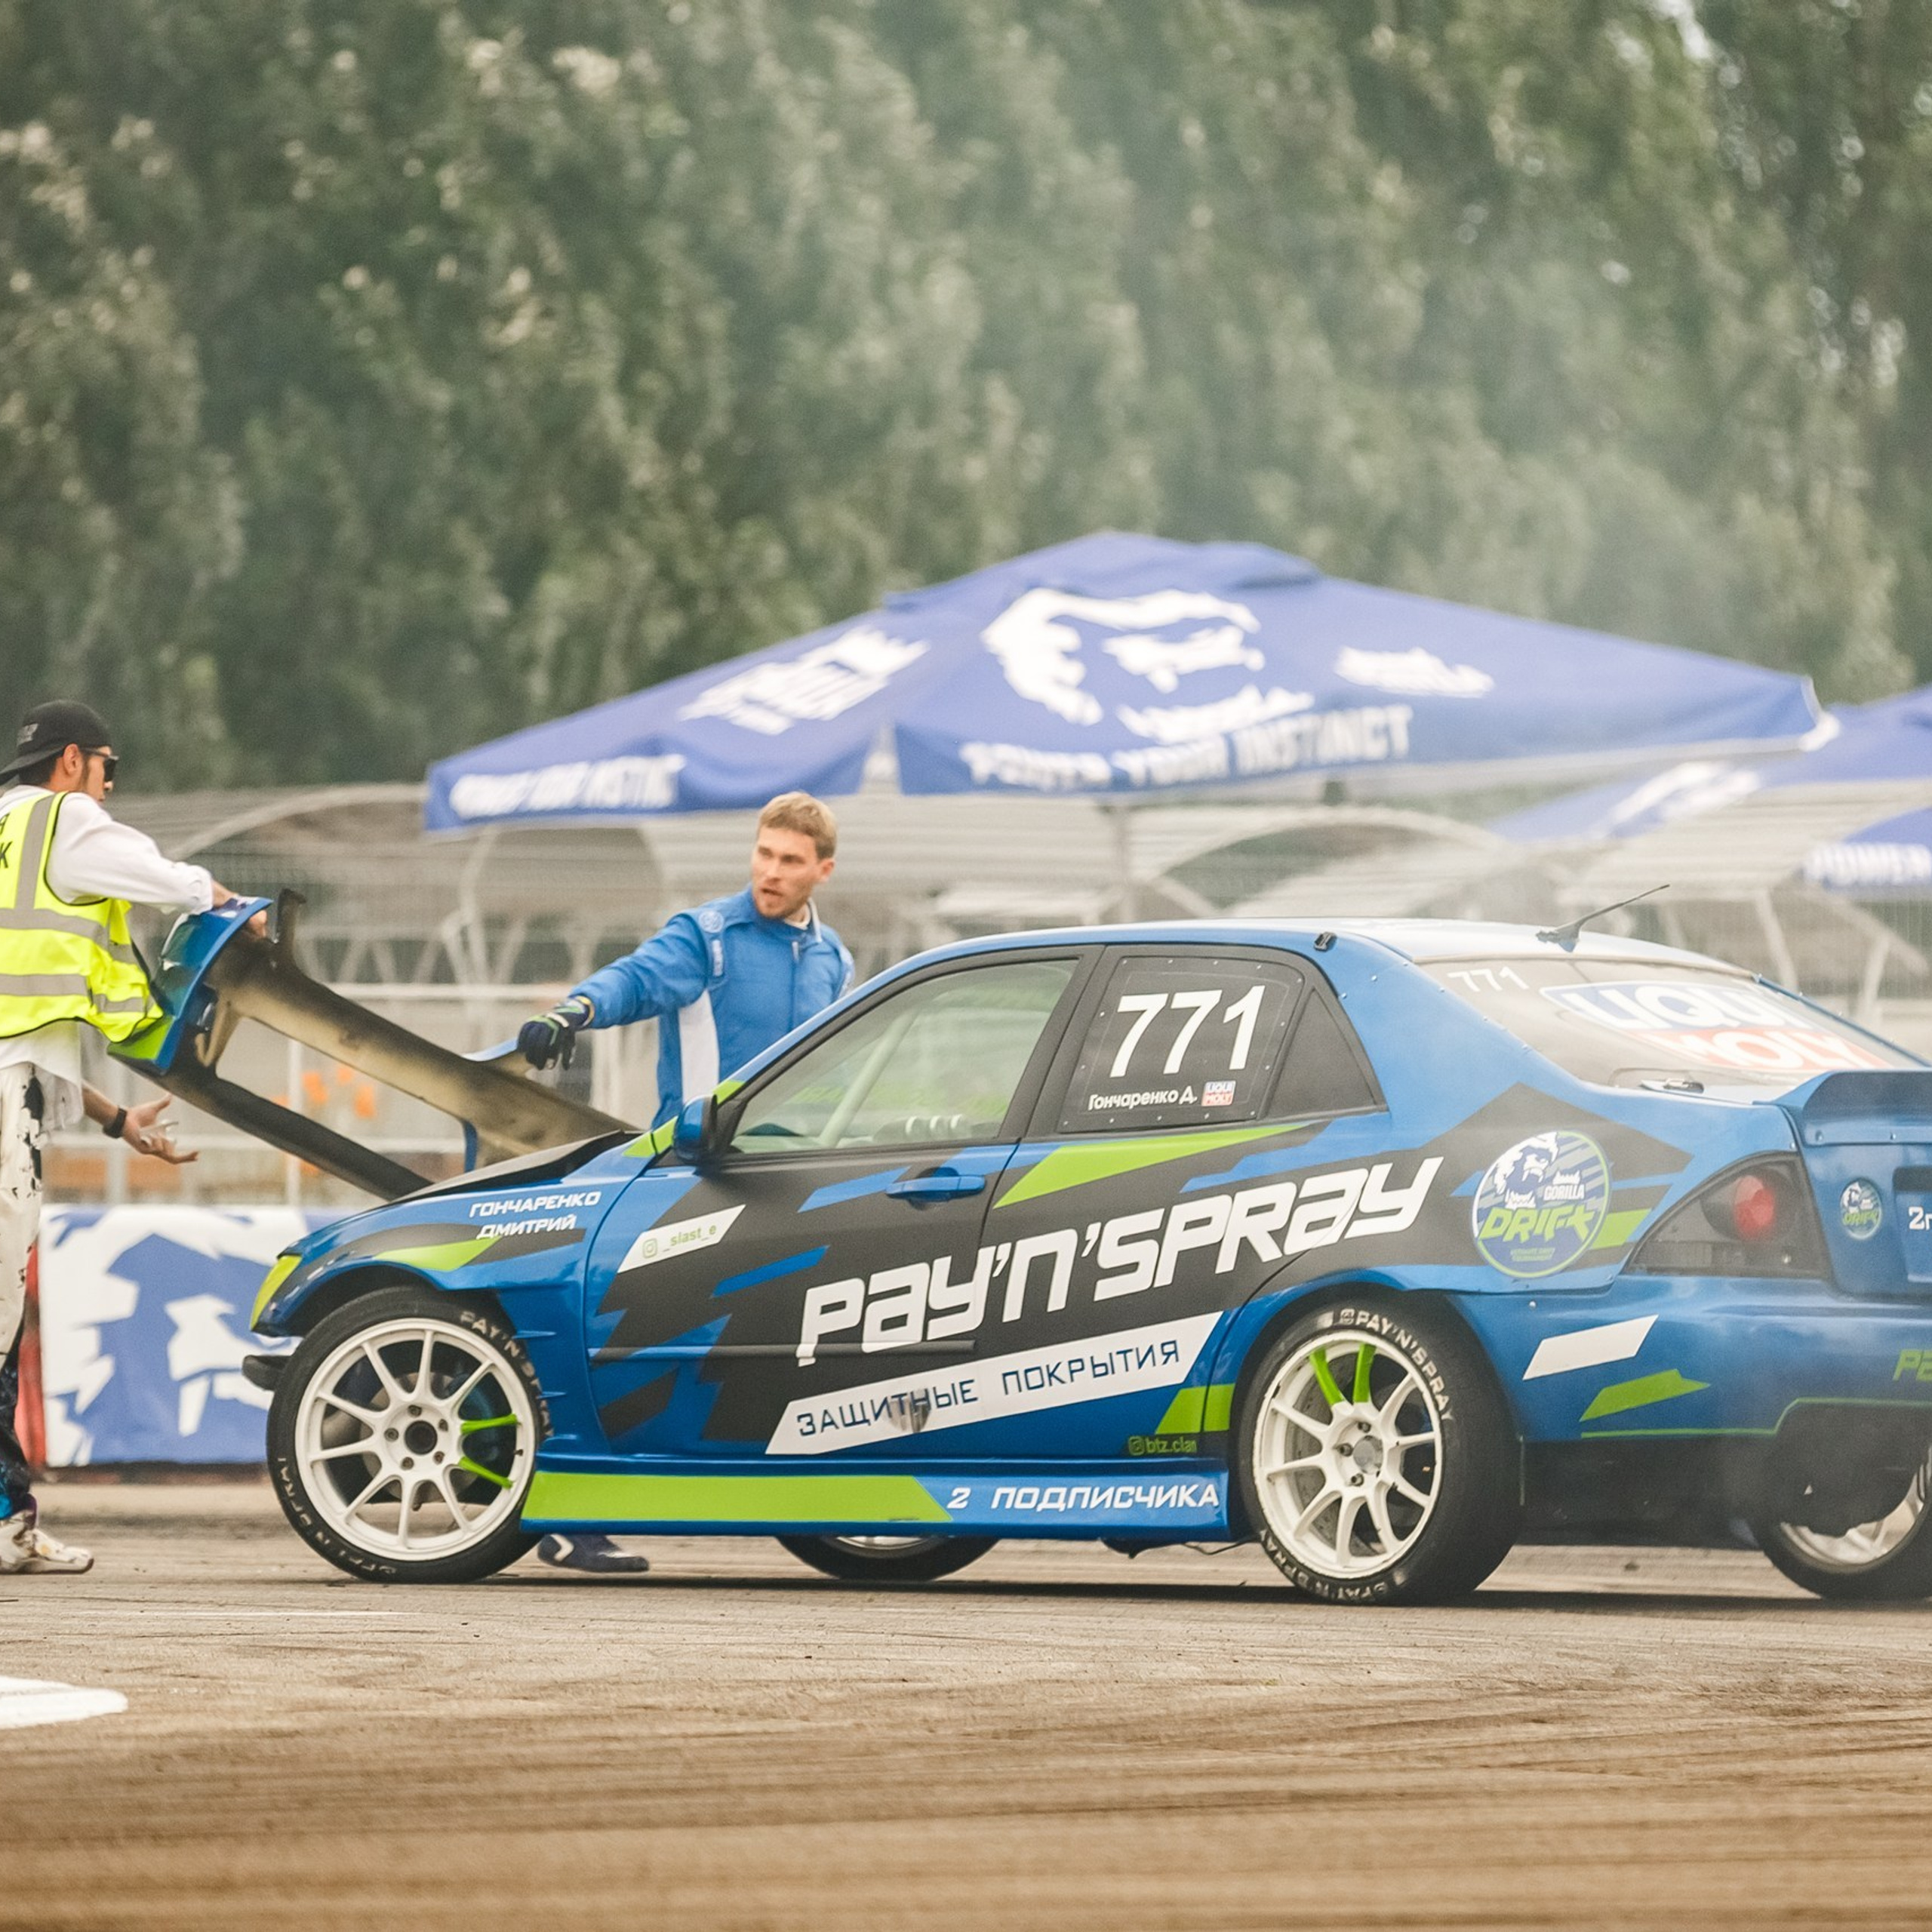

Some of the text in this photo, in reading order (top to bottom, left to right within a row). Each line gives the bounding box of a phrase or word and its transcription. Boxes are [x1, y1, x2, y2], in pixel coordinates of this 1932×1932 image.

[1447, 967, 1529, 992] 771
[1109, 985, 1266, 1078] 771
[1088, 1088, 1177, 1111] Гончаренко
[469, 1191, 602, 1218] ГОНЧАРЕНКО
[1543, 1184, 1585, 1201] GORILLA
[476, 1214, 577, 1240] ДМИТРИЙ
[1478, 1204, 1595, 1244] DRIFT
[798, 1340, 1180, 1436] ЗАЩИТНЫЕ ПОКРЫТИЯ
[947, 1484, 1220, 1512] 2 ПОДПИСЧИКА
